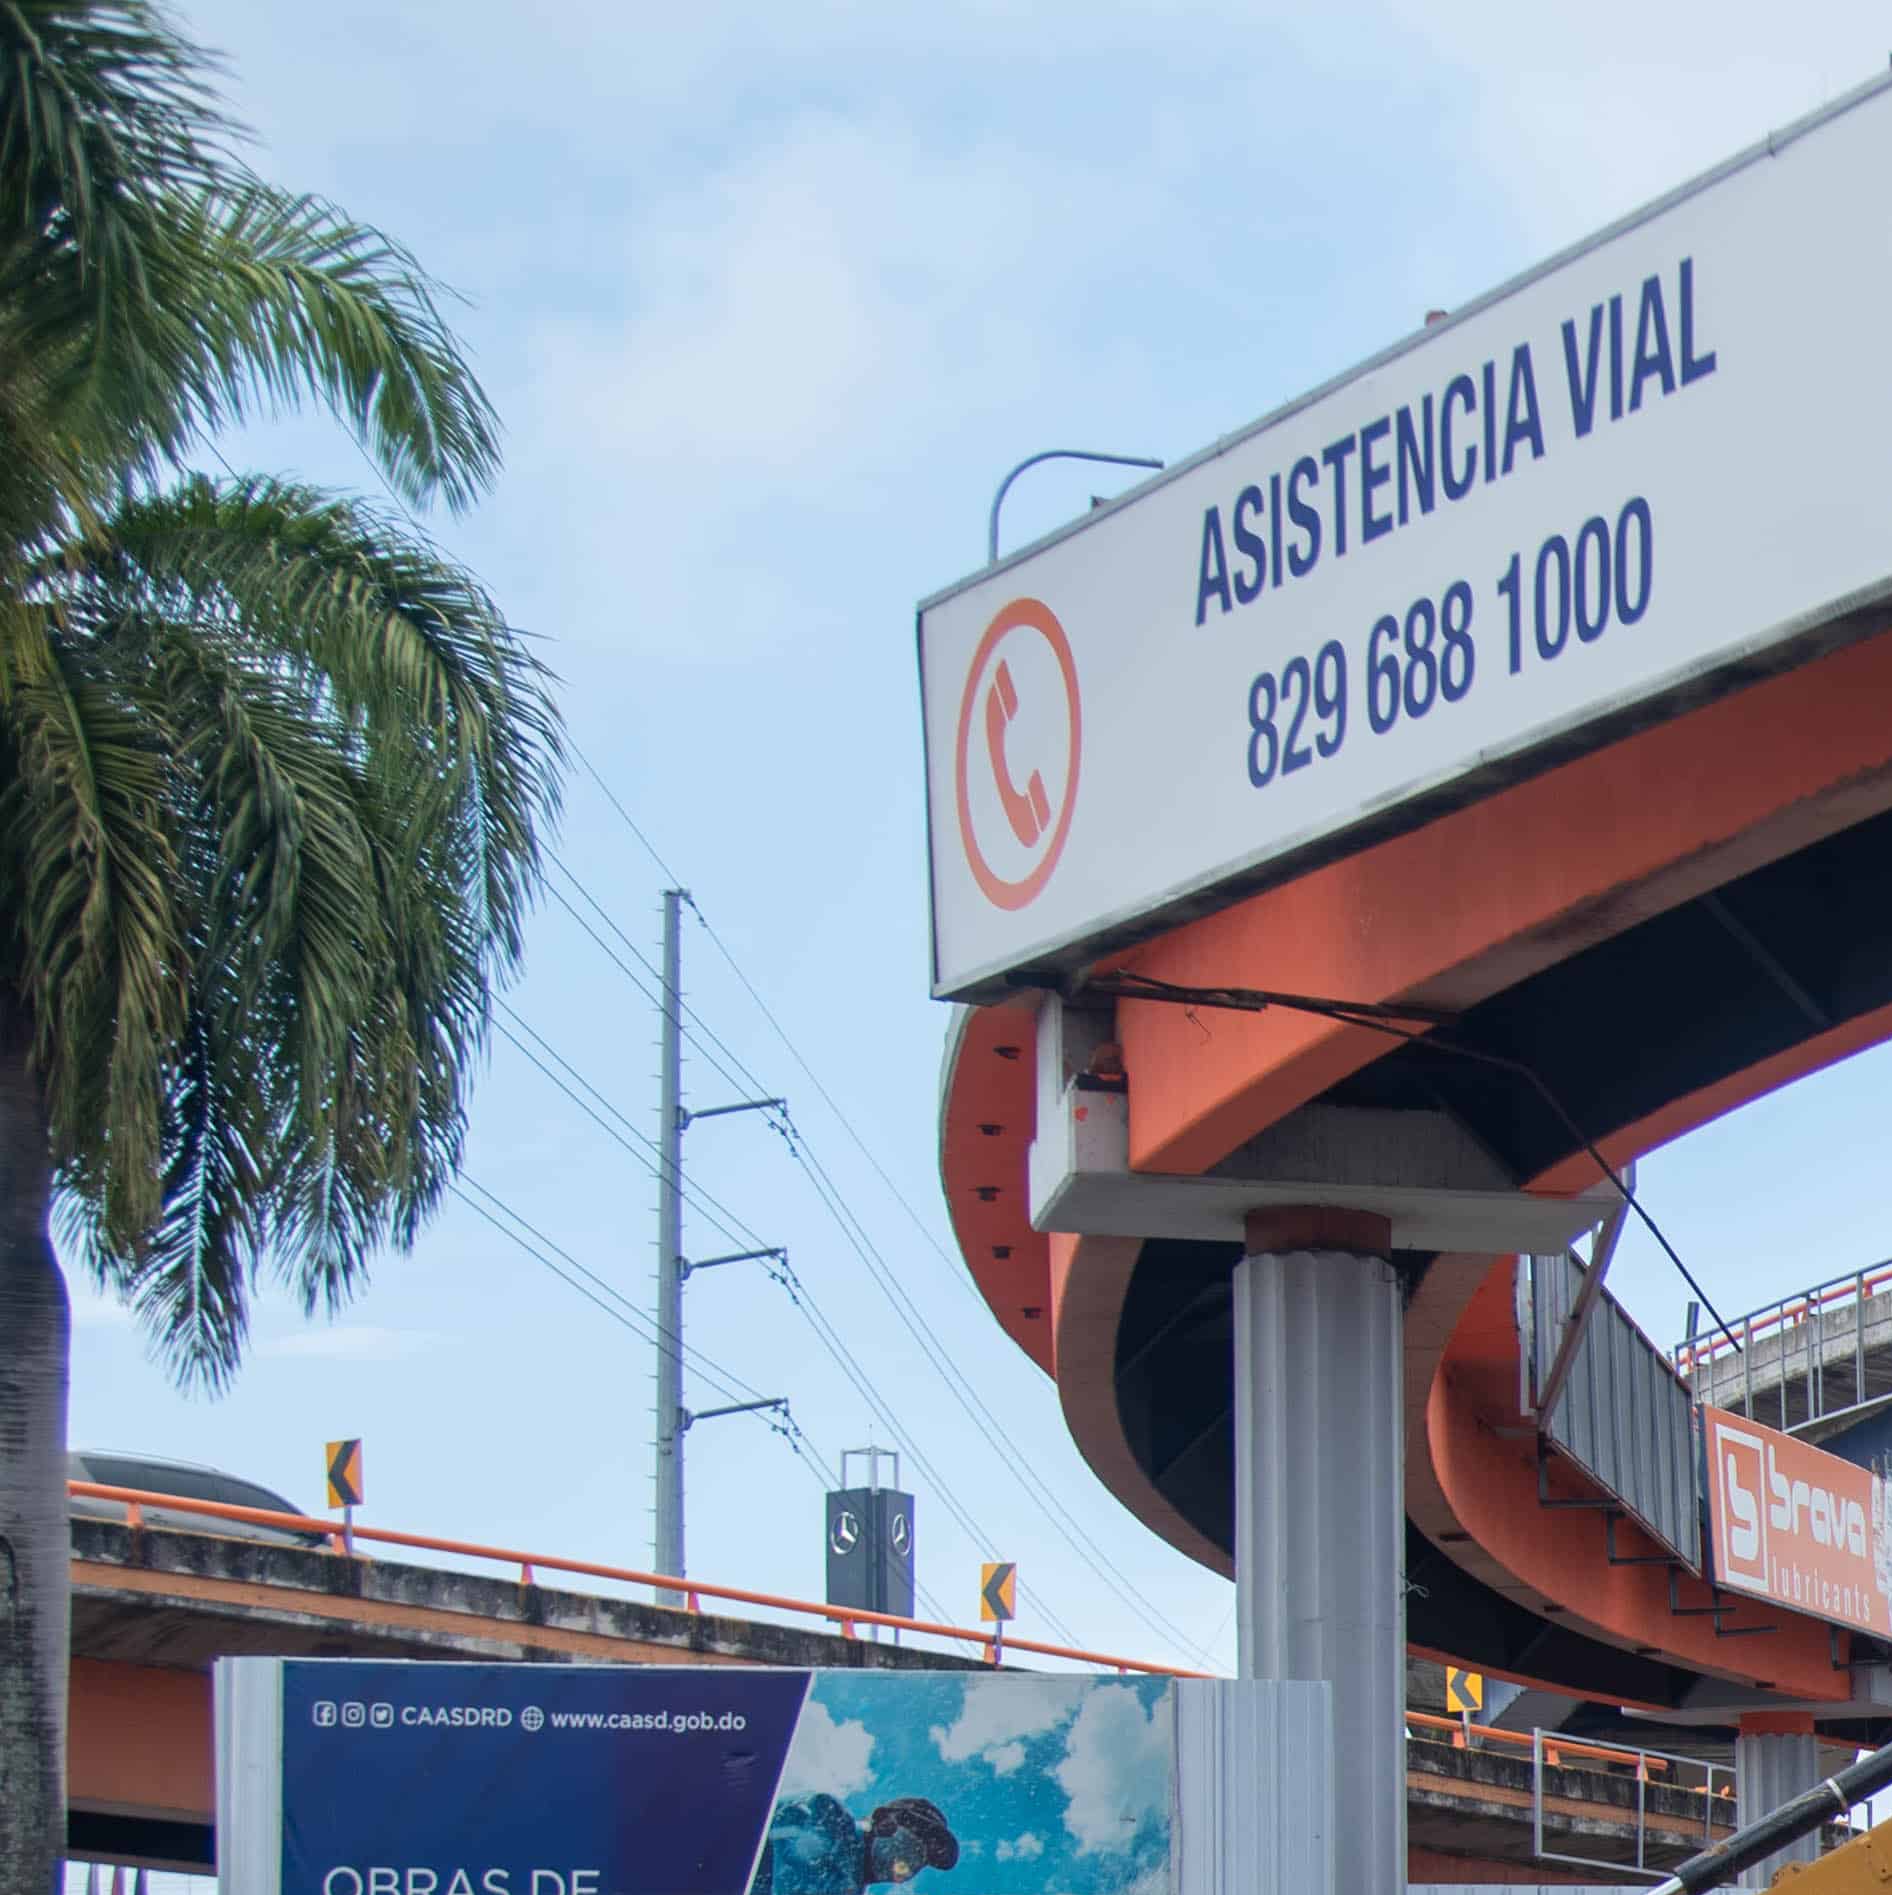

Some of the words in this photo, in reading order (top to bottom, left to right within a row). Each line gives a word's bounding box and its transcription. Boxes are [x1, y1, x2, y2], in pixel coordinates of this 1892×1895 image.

[1192, 343, 1547, 628] ASISTENCIA
[1560, 256, 1717, 435] VIAL
[1245, 640, 1347, 790] 829
[1365, 579, 1477, 736] 688
[1497, 495, 1654, 675] 1000
[1768, 1444, 1867, 1559] brava
[1772, 1556, 1871, 1621] lubricants
[401, 1706, 513, 1728] CAASDRD
[550, 1710, 746, 1733] www.caasd.gob.do
